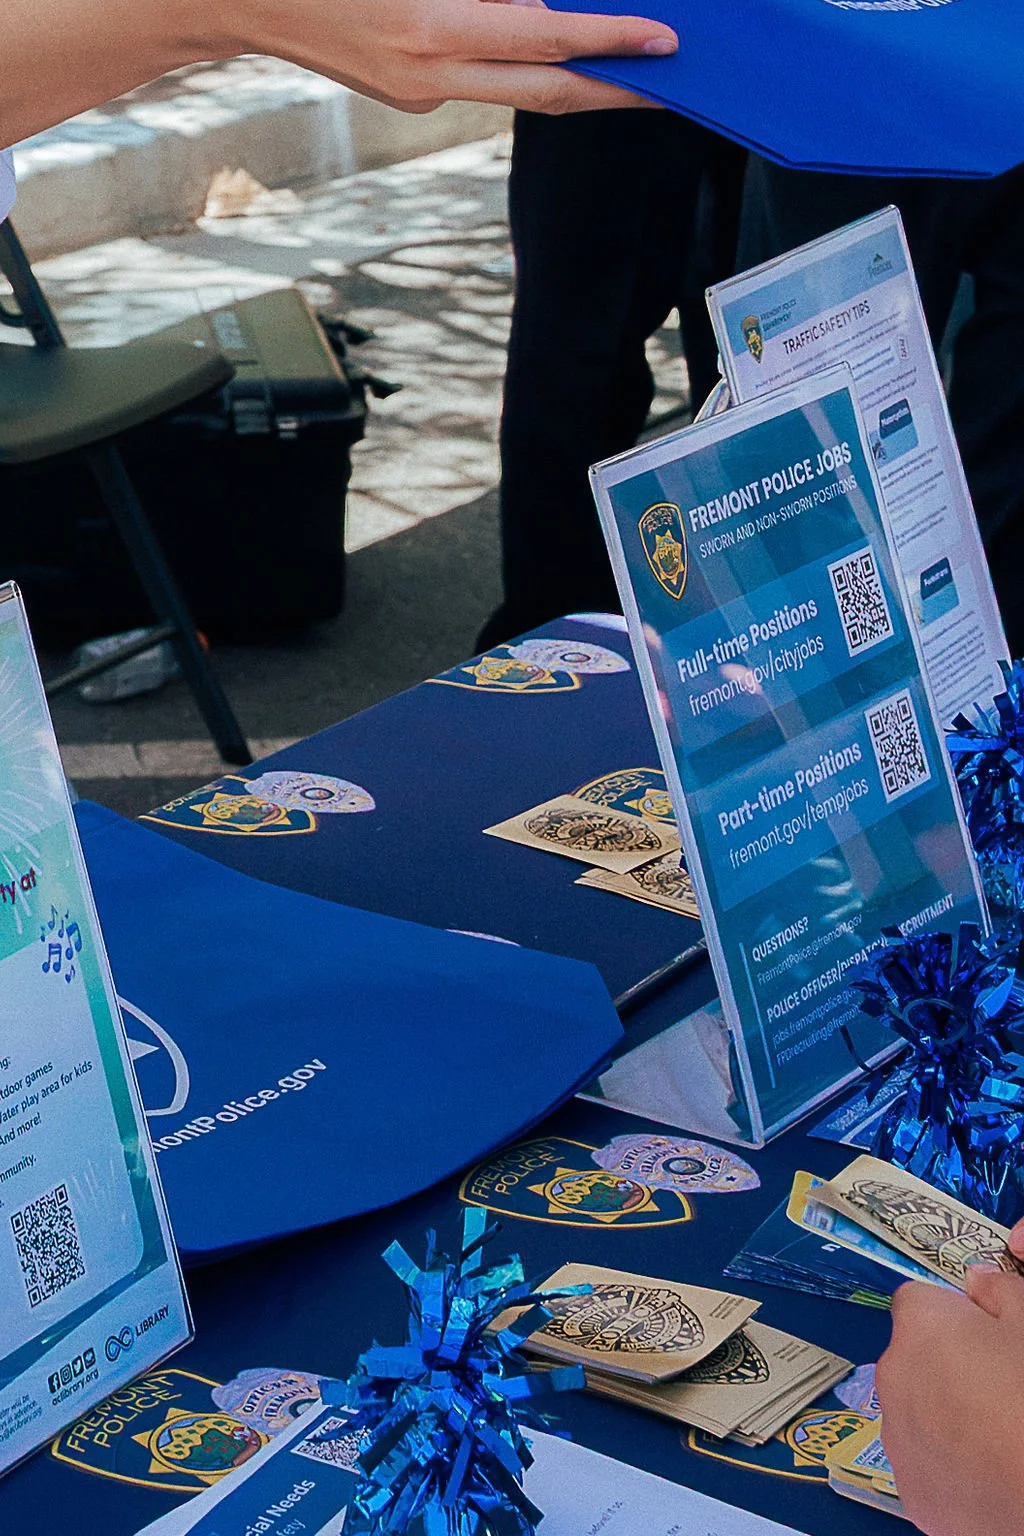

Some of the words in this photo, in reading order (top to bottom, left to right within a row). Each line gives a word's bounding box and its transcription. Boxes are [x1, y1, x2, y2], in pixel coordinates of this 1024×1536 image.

[782, 325, 820, 355] TRAFFIC
[819, 308, 854, 337] SAFETY
[852, 299, 871, 321] TIPS
[689, 481, 762, 533] FREMONT
[762, 457, 815, 500] POLICE
[816, 440, 853, 477] JOBS
[699, 531, 736, 559] SWORN
[735, 522, 756, 543] AND
[756, 495, 814, 533] NON-SWORN
[813, 474, 858, 506] POSITIONS
[677, 632, 750, 683] Full-time
[749, 598, 819, 647] Positions
[688, 634, 825, 716] fremont.gov/cityjobs
[717, 767, 796, 837] Part-time
[794, 740, 863, 797] Positions
[729, 775, 870, 870] fremont.gov/tempjobs
[19, 867, 38, 892] at
[751, 916, 810, 962] QUESTIONS?
[766, 991, 801, 1023] POLICE
[20, 1092, 41, 1114] play
[40, 1081, 61, 1099] area
[73, 1059, 94, 1079] kids
[24, 1062, 55, 1087] games
[16, 1112, 43, 1136] more!
[471, 1143, 562, 1199] FREMONT
[494, 1152, 566, 1196] POLICE
[134, 1304, 171, 1338] LIBRARY
[66, 1376, 178, 1454] FREMONT
[93, 1388, 183, 1449] POLICE
[265, 1479, 317, 1518] Needs
